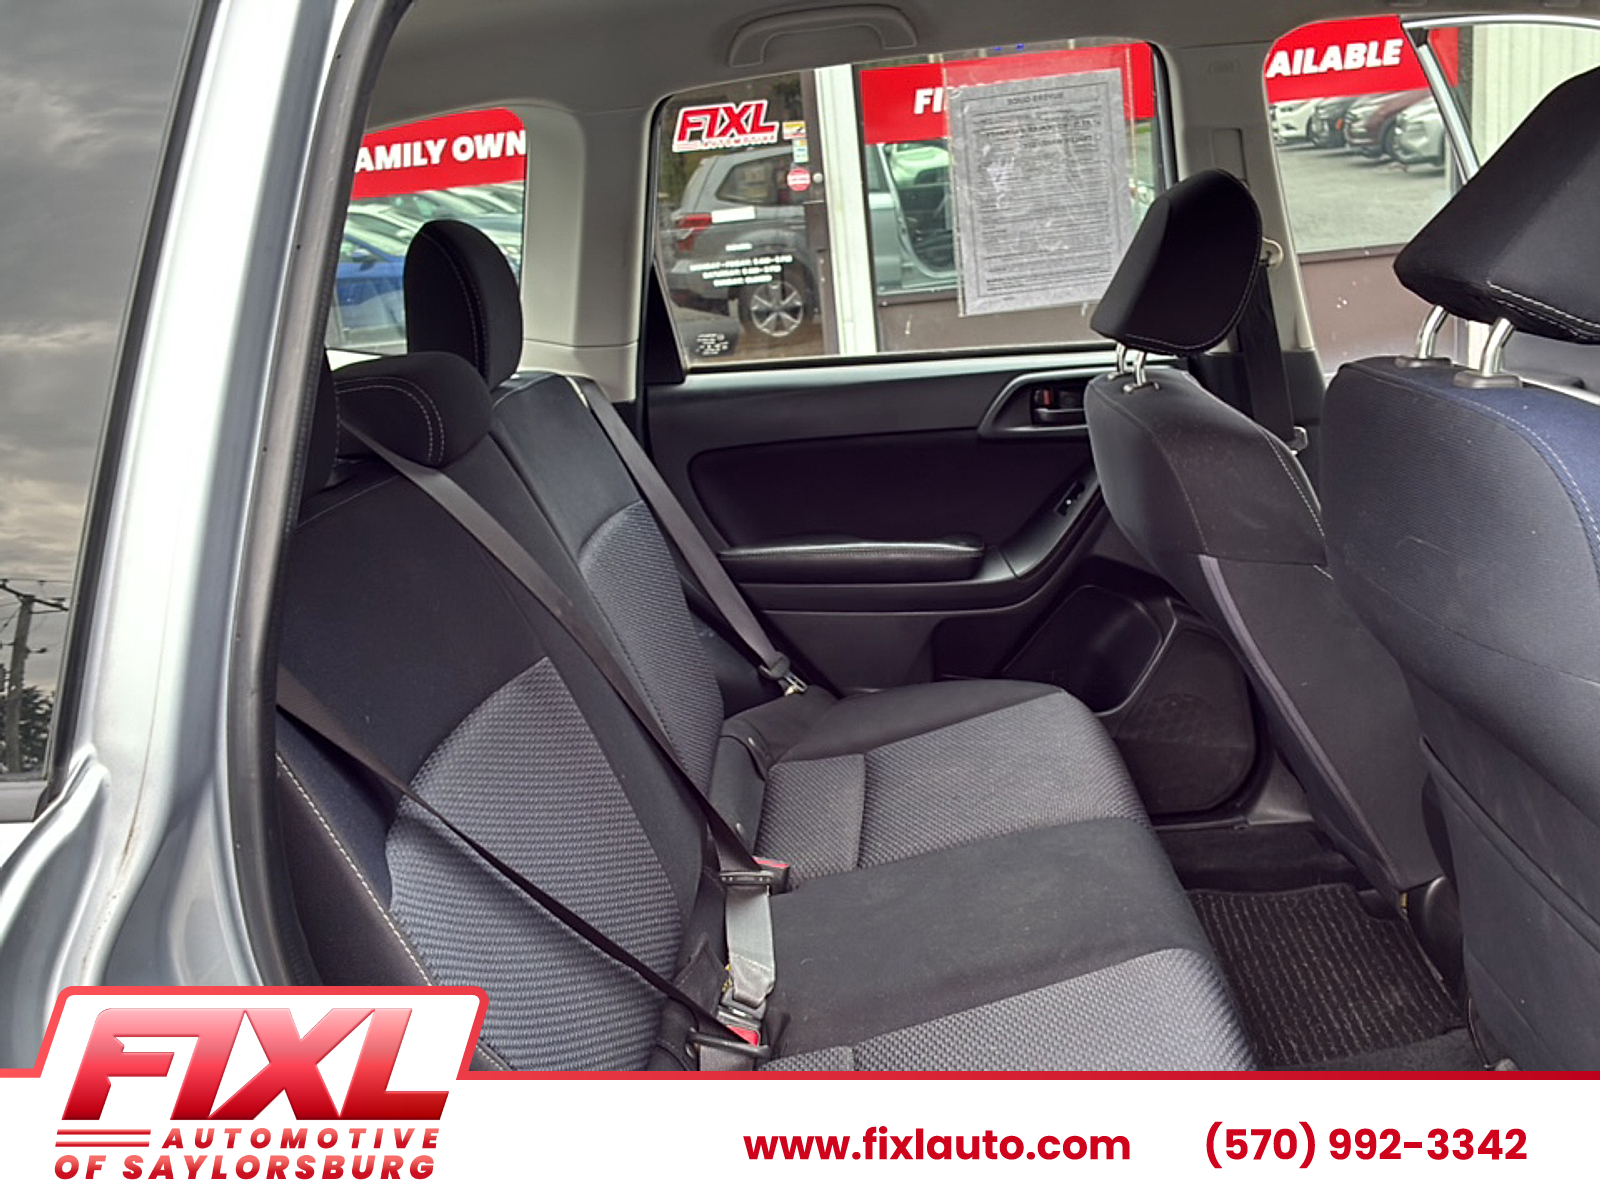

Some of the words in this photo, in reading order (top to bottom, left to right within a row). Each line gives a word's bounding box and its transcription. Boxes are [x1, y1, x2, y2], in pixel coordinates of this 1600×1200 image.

[1266, 38, 1403, 78] AILABLE
[914, 87, 943, 114] FI
[676, 103, 778, 141] FIXL
[354, 138, 447, 173] AMILY
[452, 130, 526, 162] OWN
